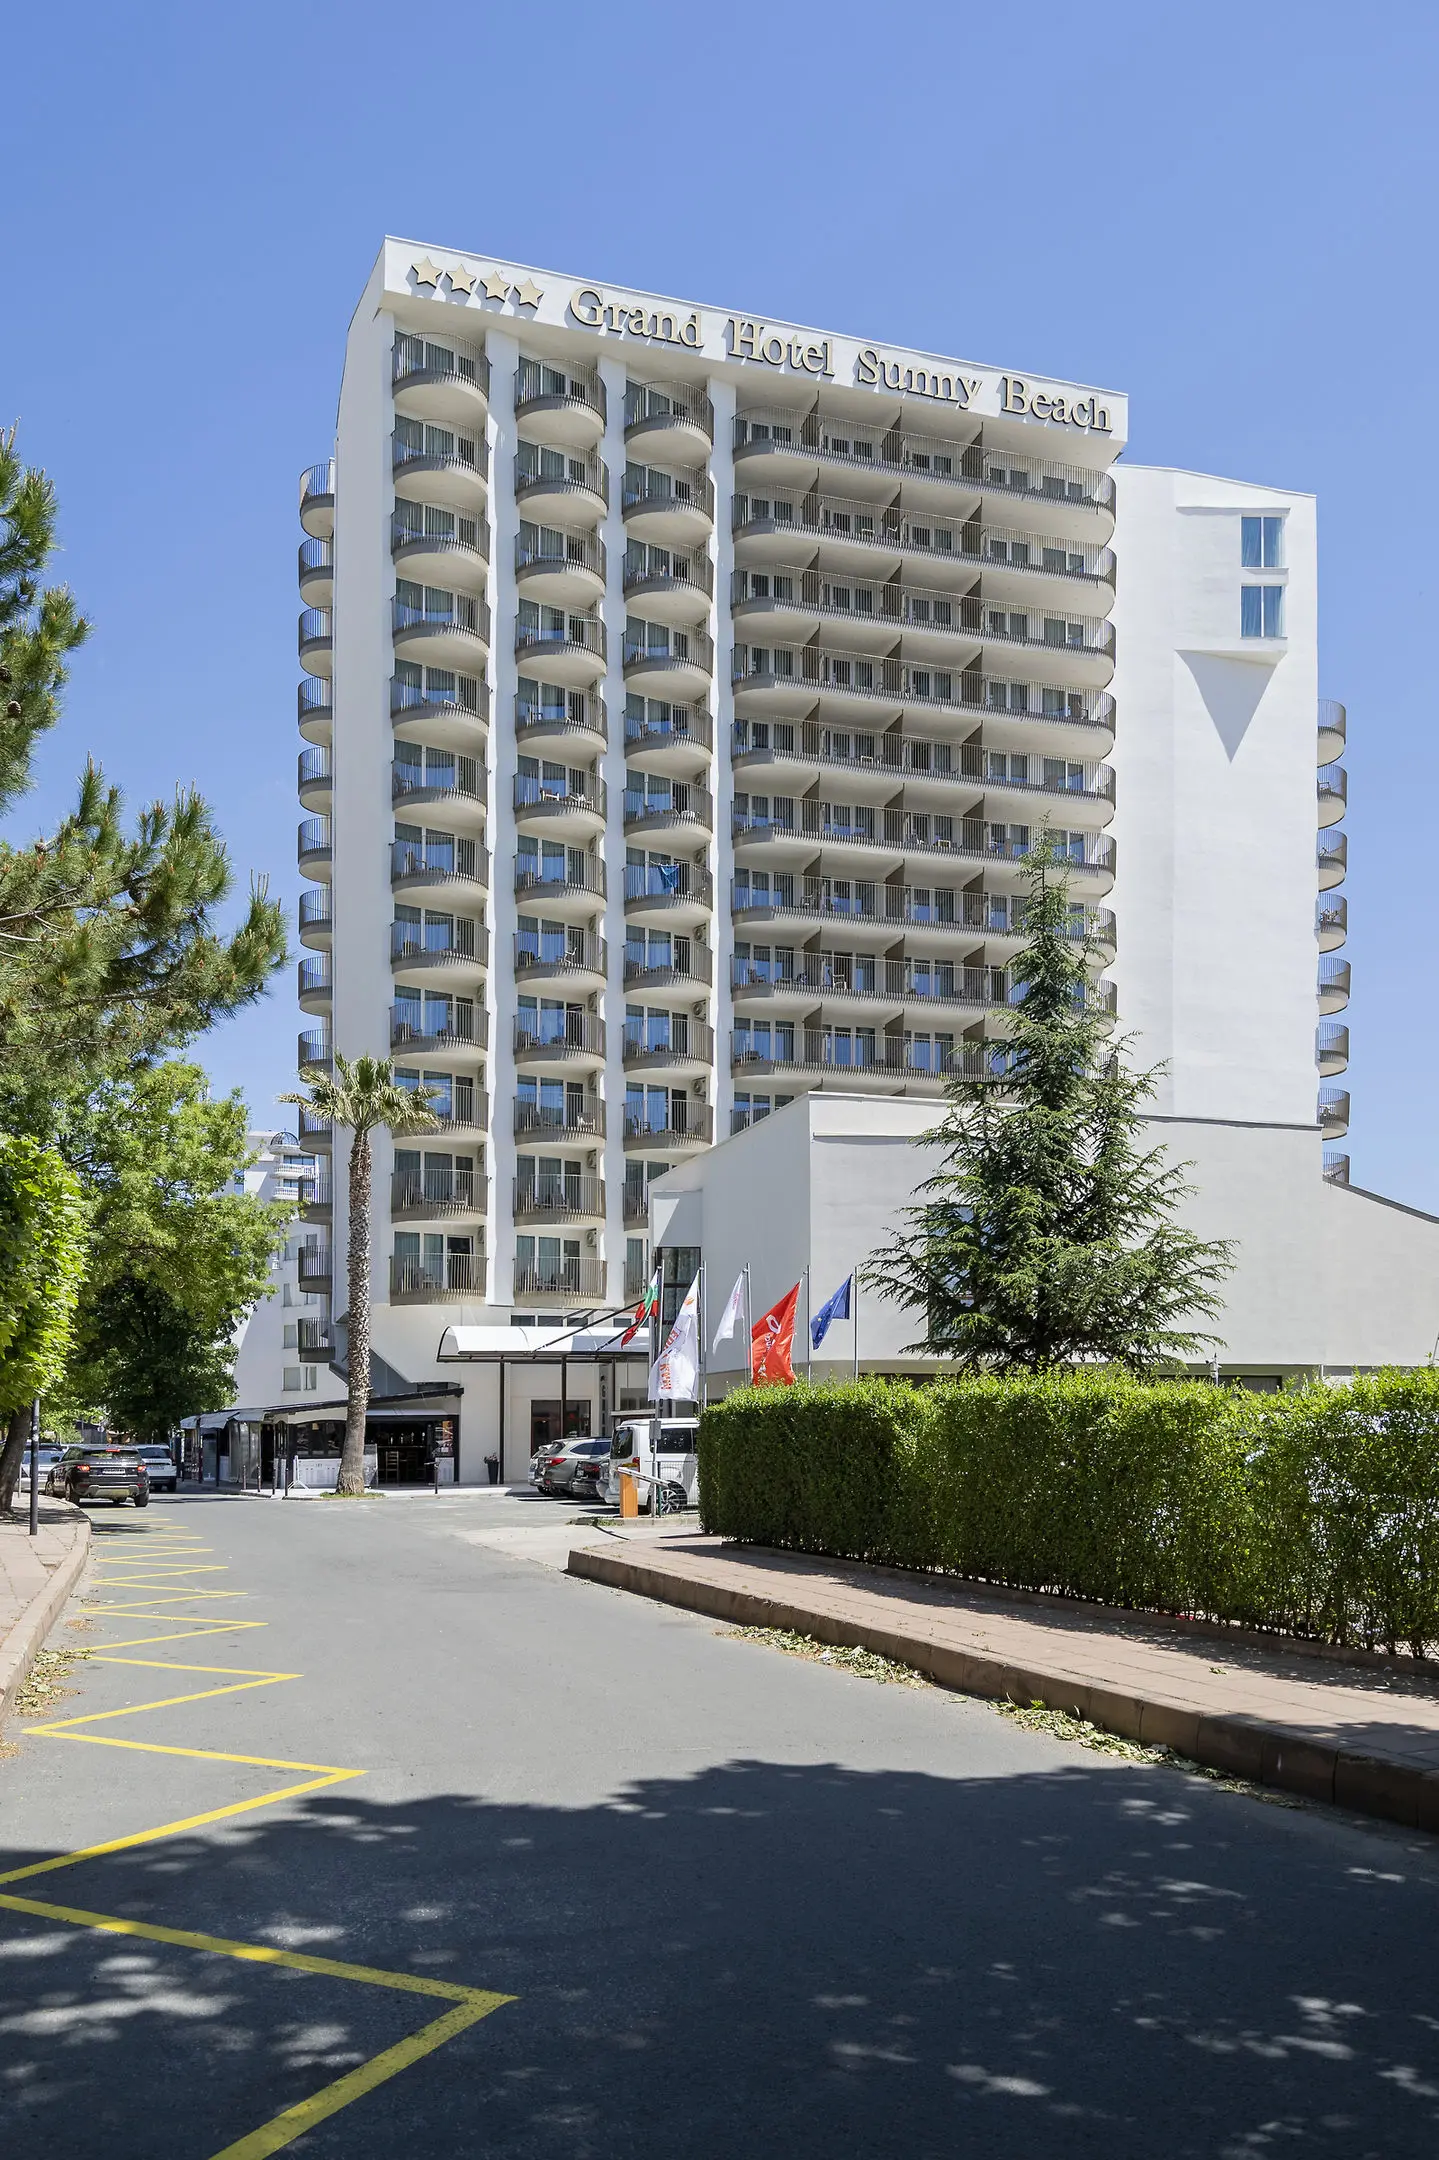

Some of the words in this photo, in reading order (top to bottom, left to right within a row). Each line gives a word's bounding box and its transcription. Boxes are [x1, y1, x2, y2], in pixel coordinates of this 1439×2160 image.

[570, 287, 704, 348] Grand
[728, 318, 835, 375] Hotel
[858, 346, 982, 409] Sunny
[1001, 375, 1113, 431] Beach
